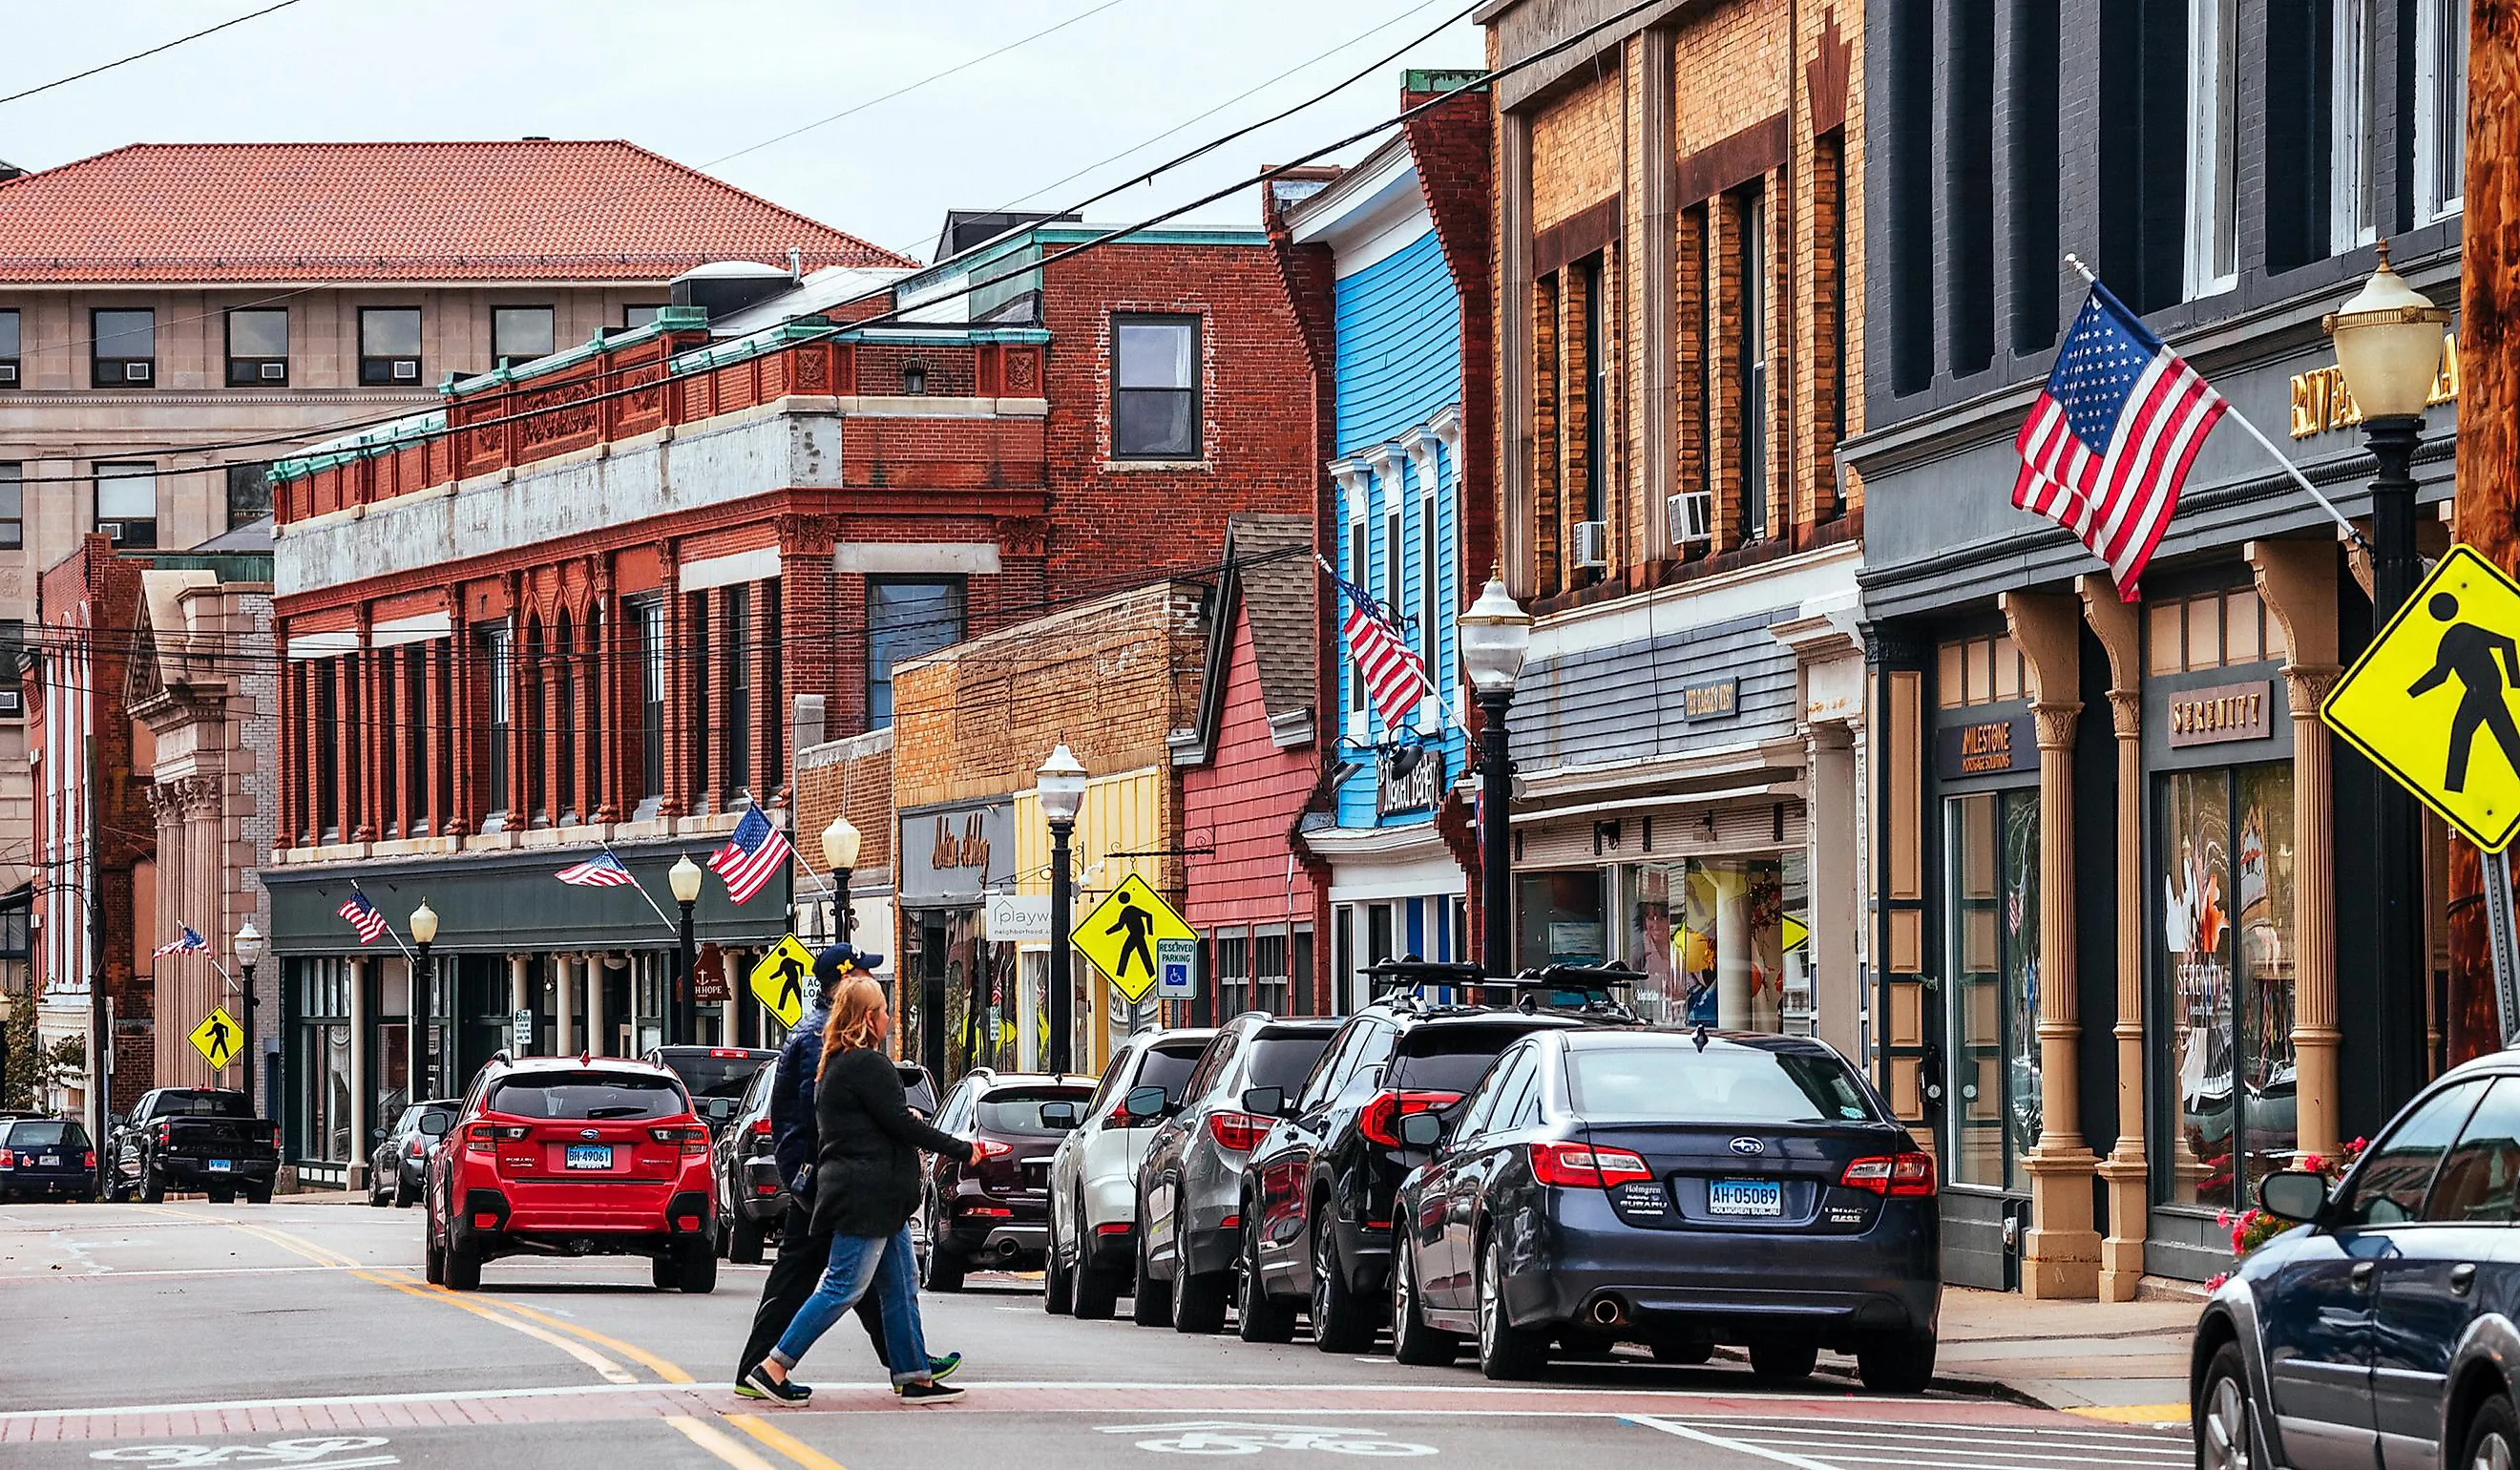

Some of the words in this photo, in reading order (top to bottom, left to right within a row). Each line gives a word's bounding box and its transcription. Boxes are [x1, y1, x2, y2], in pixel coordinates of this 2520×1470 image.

[2173, 693, 2260, 734] SERENITY
[1962, 722, 2010, 755] MILESTONE
[999, 908, 1050, 926] playw
[994, 928, 1043, 936] neighborhood
[1159, 943, 1193, 953] RESERVED
[1162, 955, 1190, 963] PARKING
[2176, 964, 2224, 997] SERENITY
[1626, 1184, 1661, 1195] Holmgren
[1620, 1200, 1668, 1209] SUBARU
